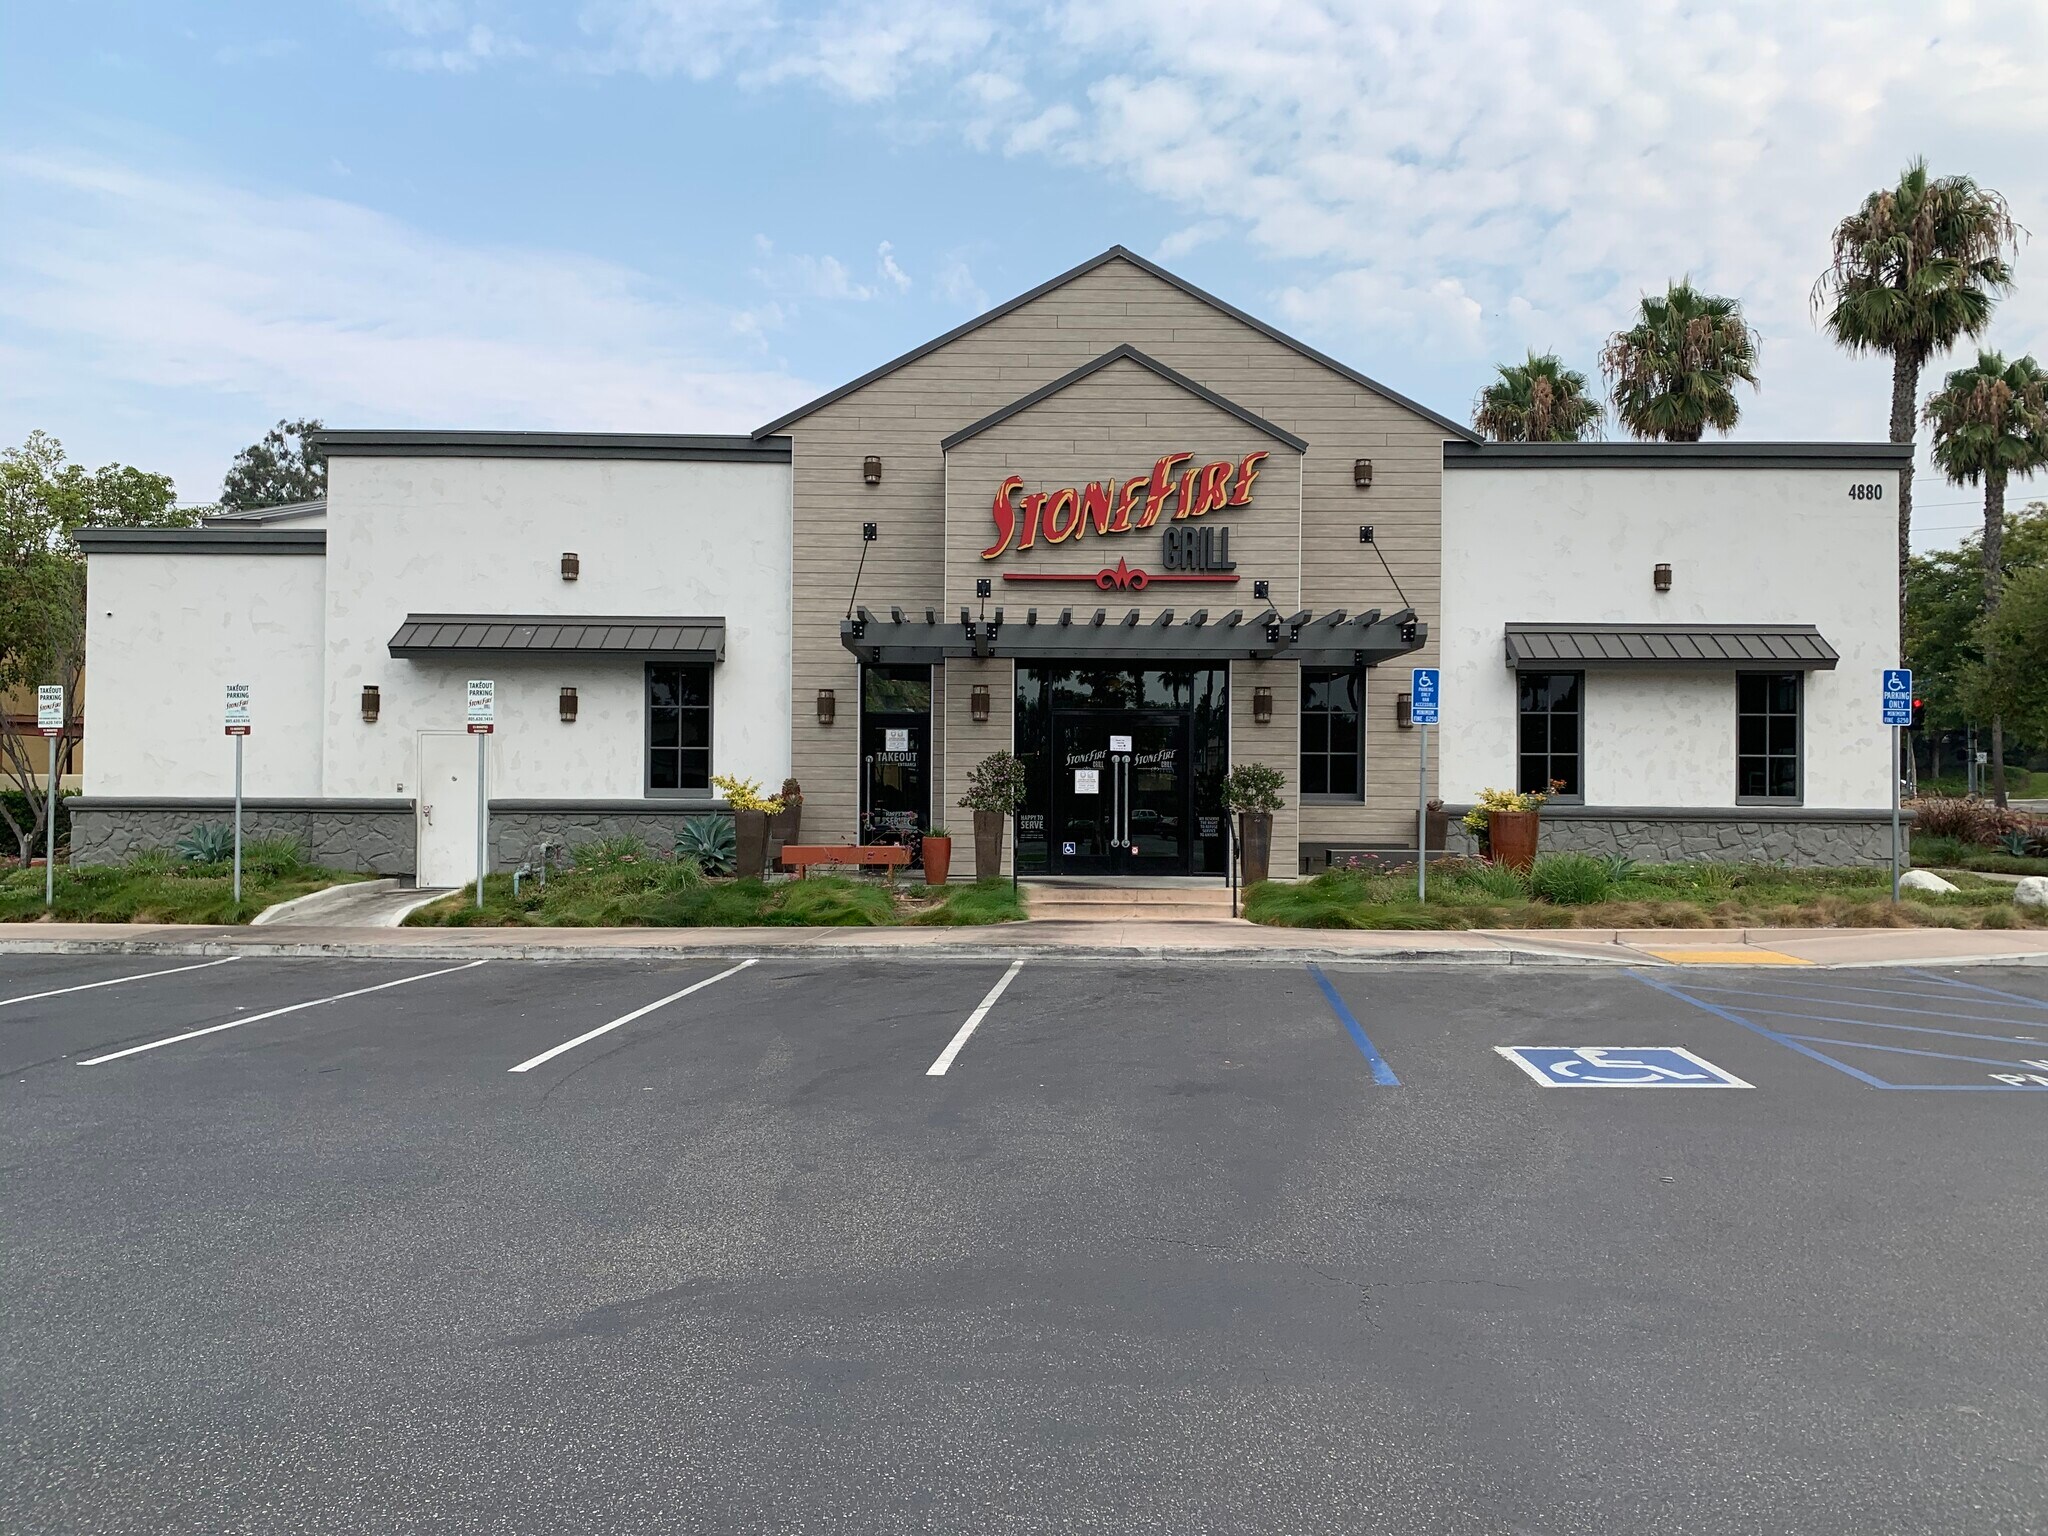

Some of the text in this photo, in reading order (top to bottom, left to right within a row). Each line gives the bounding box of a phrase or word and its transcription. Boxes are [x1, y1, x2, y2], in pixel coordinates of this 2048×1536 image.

[1848, 483, 1883, 500] 4880
[1162, 526, 1237, 571] GRILL
[1884, 691, 1910, 700] PARKING
[1888, 700, 1905, 709] ONLY
[876, 752, 918, 762] TAKEOUT
[1020, 821, 1044, 829] SERVE
